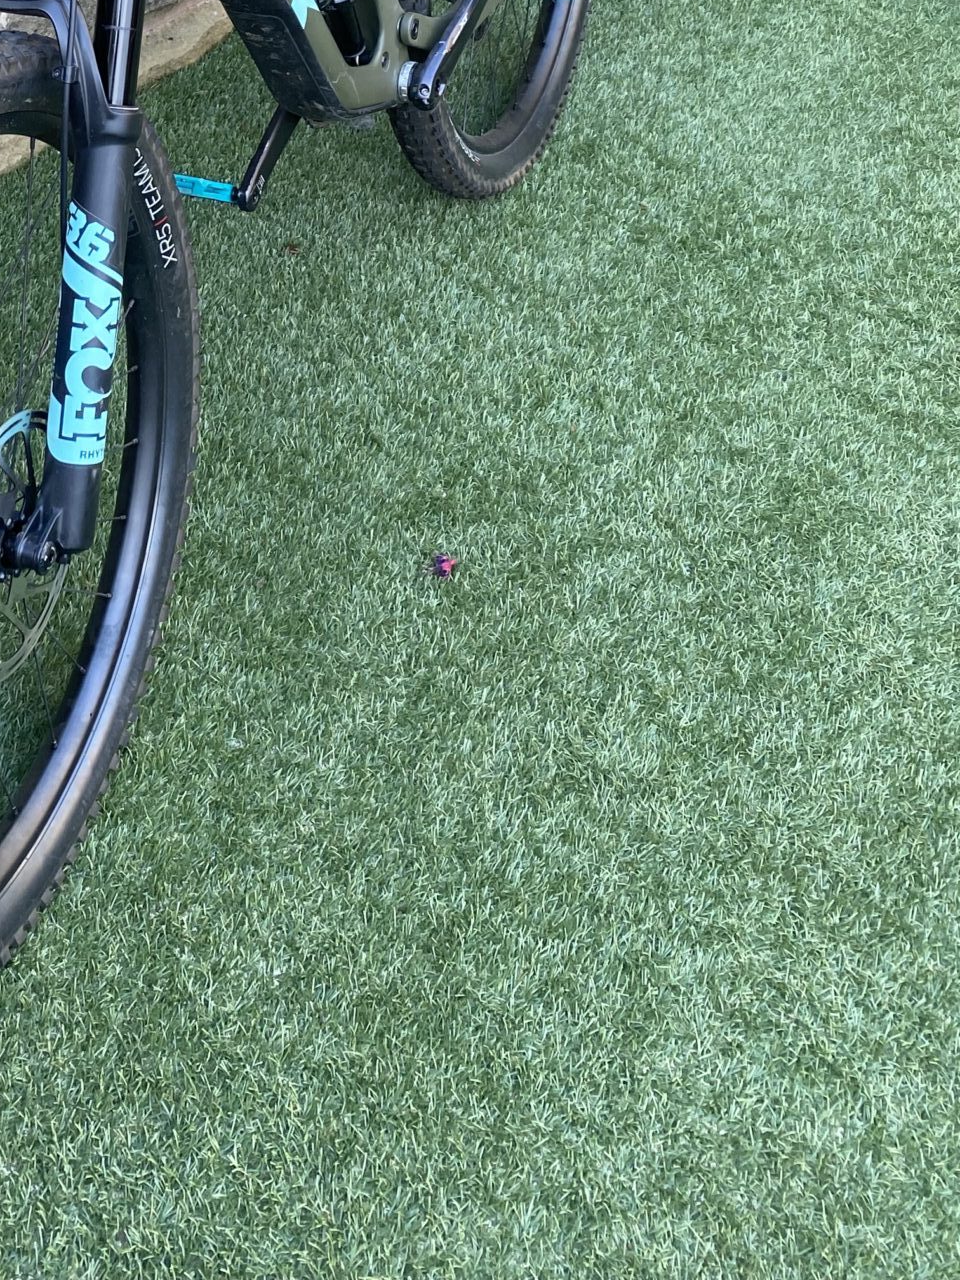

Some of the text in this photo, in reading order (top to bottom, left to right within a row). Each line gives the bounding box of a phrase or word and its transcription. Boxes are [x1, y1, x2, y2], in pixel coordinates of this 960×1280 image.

[133, 163, 165, 221] TEAM
[66, 201, 116, 264] 36
[61, 297, 121, 440] FOX
